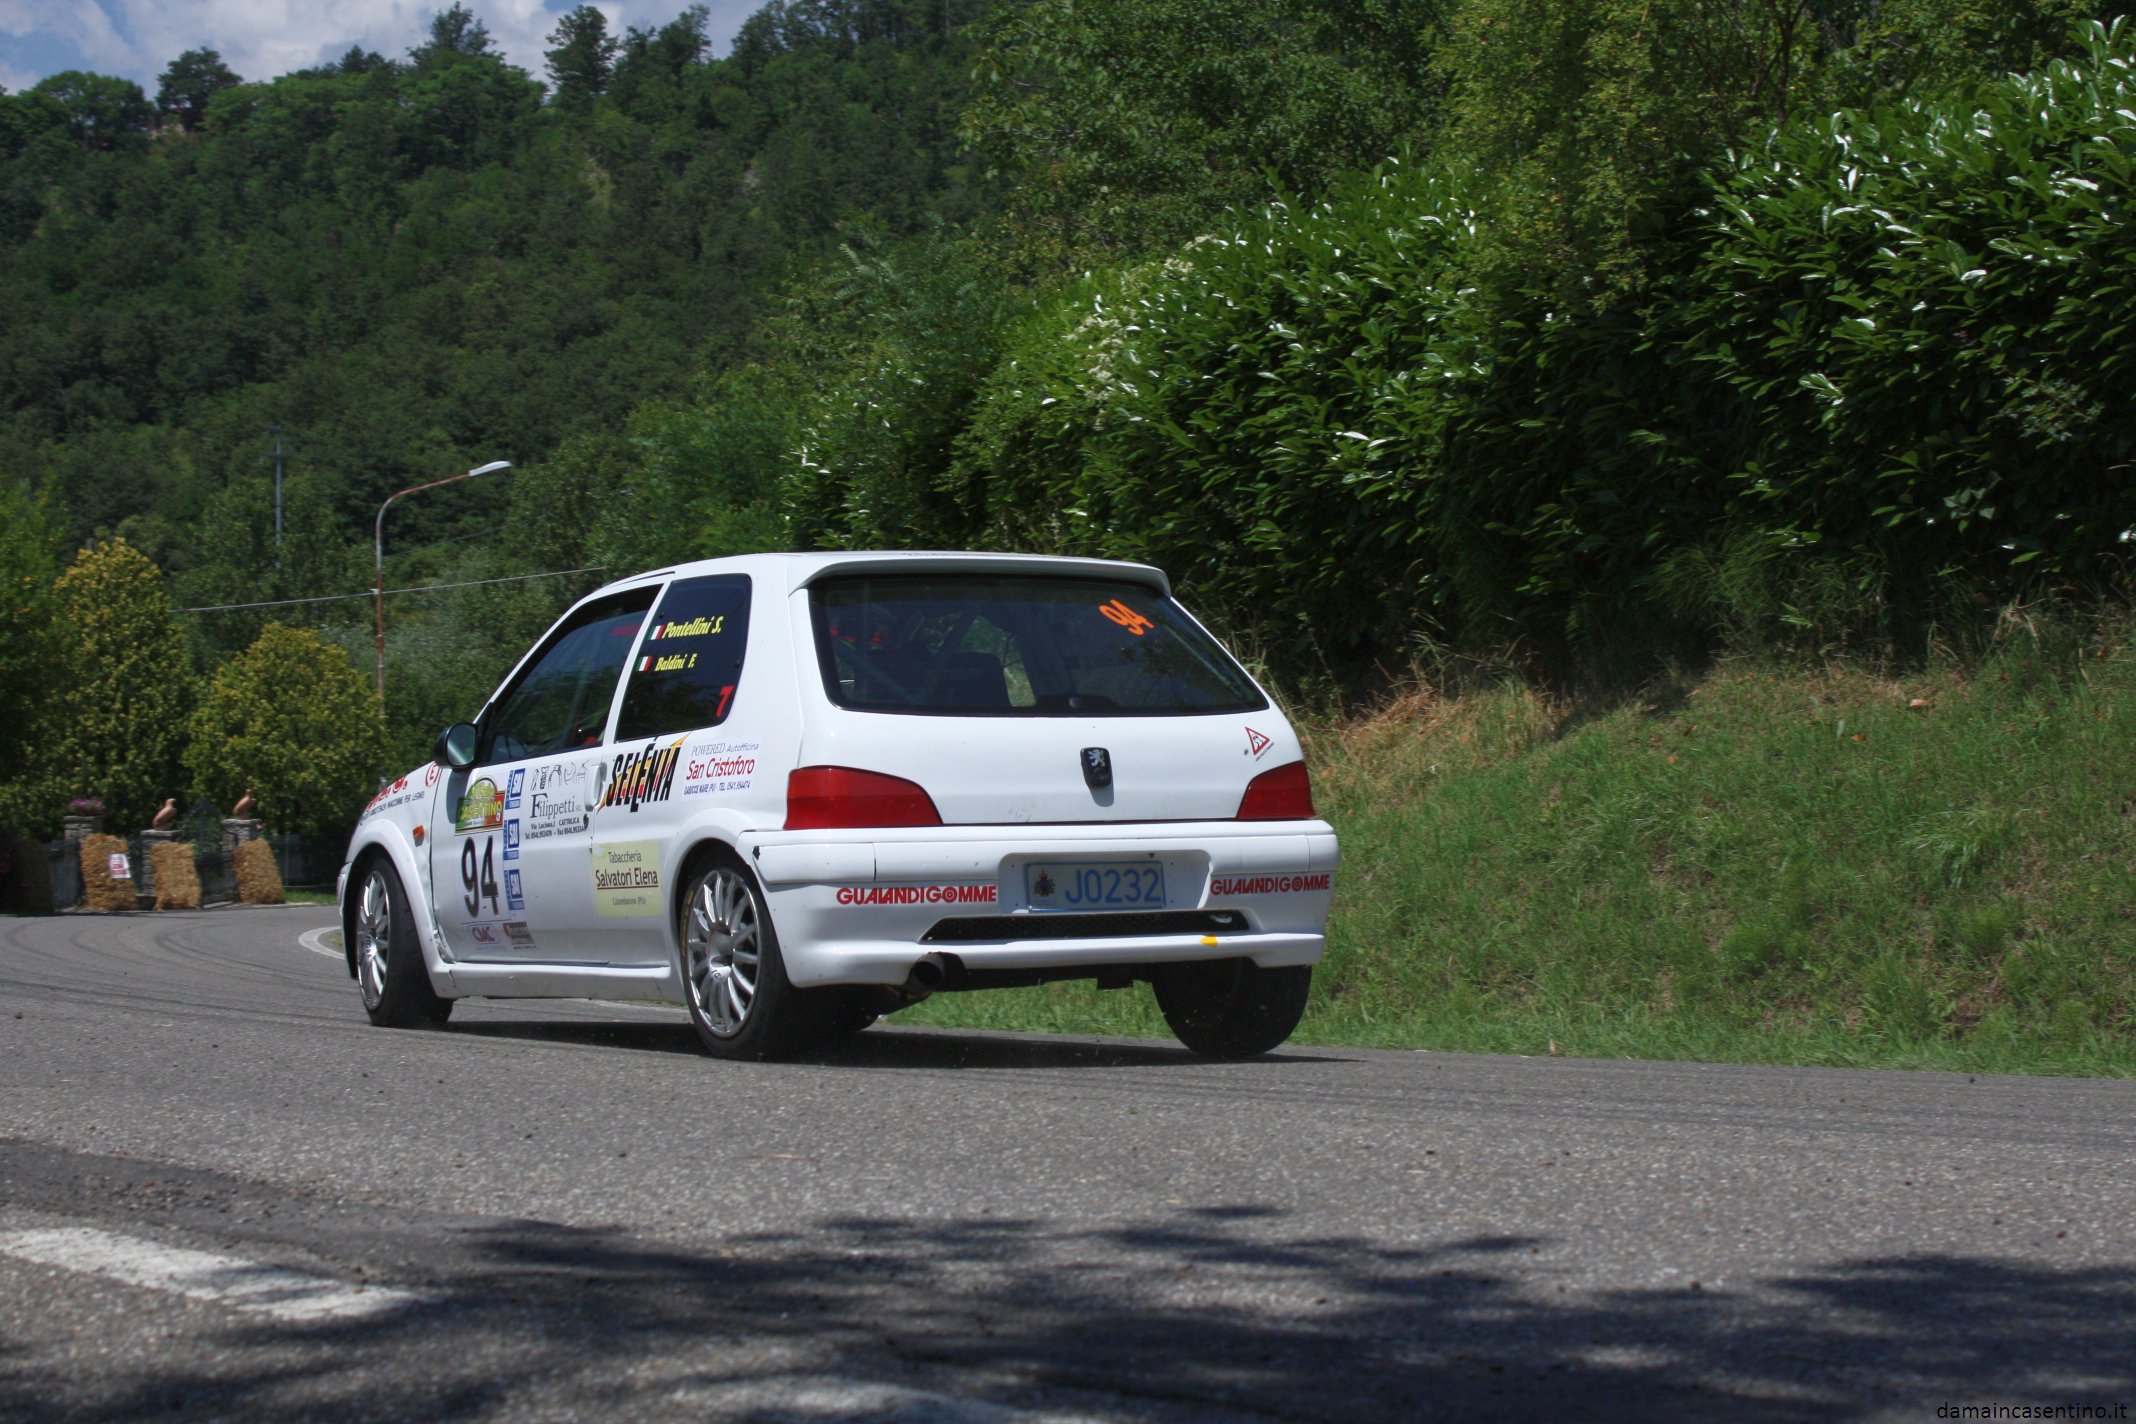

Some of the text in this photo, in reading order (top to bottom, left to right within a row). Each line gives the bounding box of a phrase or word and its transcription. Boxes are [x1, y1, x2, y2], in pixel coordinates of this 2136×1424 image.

[661, 616, 713, 639] Pontellini
[1099, 599, 1154, 635] 94
[654, 654, 688, 672] Baldini
[691, 742, 759, 757] POWERED Autofficina
[605, 743, 682, 813] SELENIA
[686, 755, 755, 780] San Cristoforo
[529, 793, 575, 820] Filippetti
[608, 850, 642, 864] Tabaccheria
[461, 835, 500, 919] 94
[595, 867, 659, 888] Salvatori Elena
